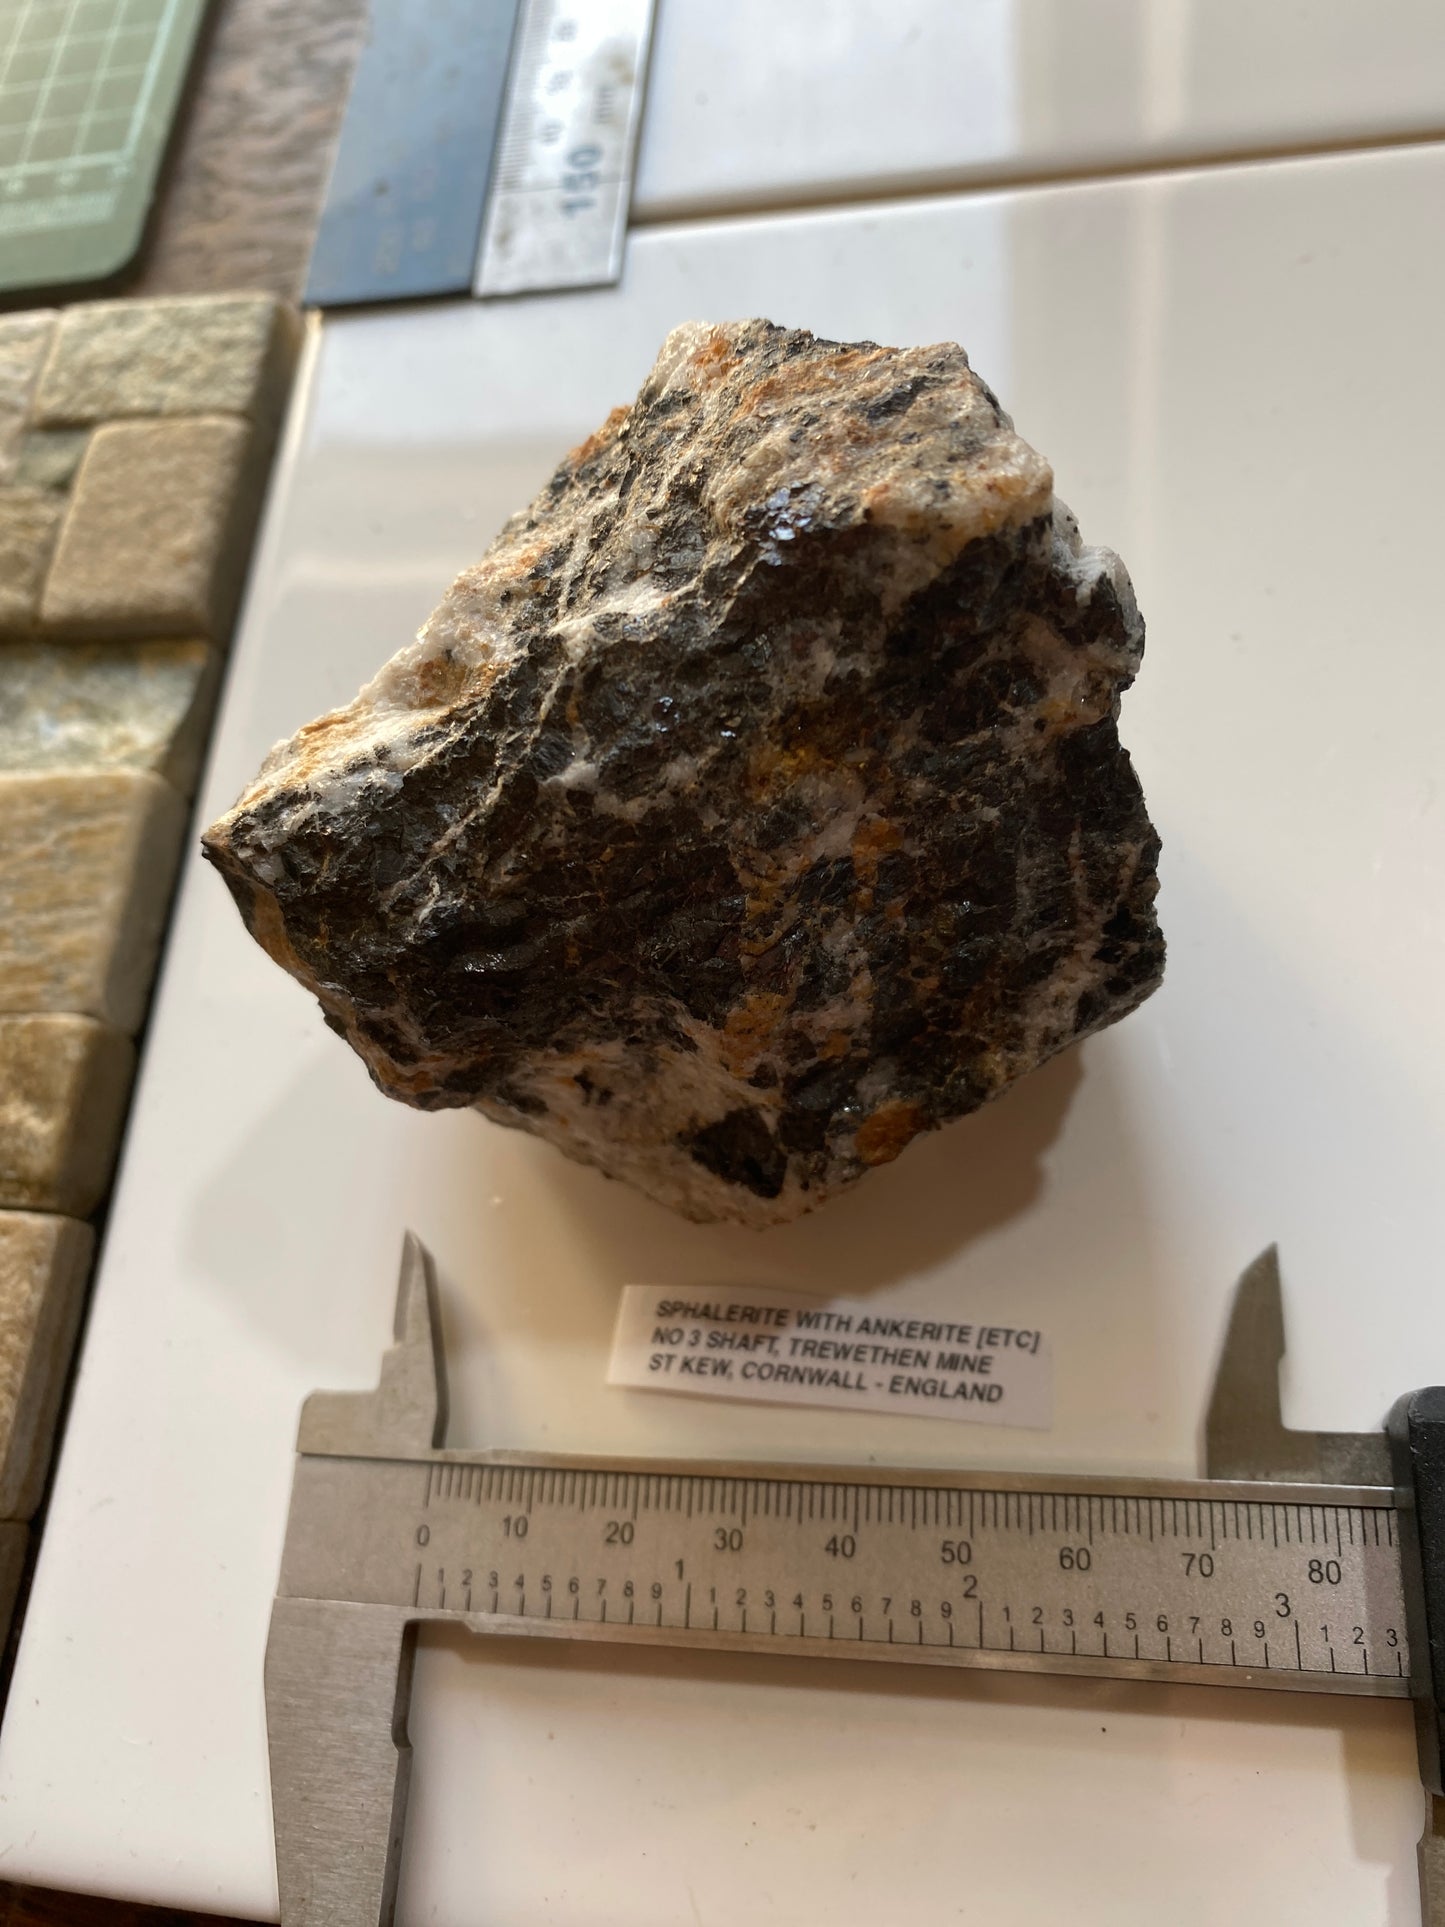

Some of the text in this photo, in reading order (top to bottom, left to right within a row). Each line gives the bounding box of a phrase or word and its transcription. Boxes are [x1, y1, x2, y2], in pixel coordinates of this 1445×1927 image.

[560, 143, 603, 219] 150
[652, 1327, 994, 1374] NO 3 SHAFT, TREWETHEN MINE
[656, 1300, 1041, 1354] SPHALERITE WITH ANKERITE [ETC]
[649, 1353, 676, 1371] ST
[680, 1355, 733, 1380] KEW,
[741, 1361, 867, 1390] CORNWALL
[888, 1375, 1004, 1402] ENGLAND
[416, 1515, 1342, 1585] 0 10 20 30 40 50 60 70 80
[462, 1570, 473, 1586] 2
[489, 1571, 498, 1588] 3
[514, 1574, 525, 1588] 4
[543, 1575, 552, 1591] 5
[569, 1577, 579, 1594] 6
[597, 1579, 606, 1595] 7
[624, 1581, 634, 1597] 8
[652, 1583, 662, 1599] 9
[736, 1588, 747, 1605] 2
[765, 1590, 775, 1607] 3
[793, 1593, 803, 1608] 4
[822, 1594, 832, 1611] 5
[852, 1596, 862, 1613] 6
[882, 1598, 891, 1614] 7
[911, 1600, 921, 1616] 8
[941, 1602, 951, 1618] 9
[963, 1575, 978, 1598] 2
[1032, 1607, 1043, 1623] 2
[1063, 1609, 1074, 1626] 3
[1093, 1611, 1104, 1628] 4
[1125, 1613, 1136, 1630] 5
[1157, 1615, 1168, 1632] 6
[1190, 1617, 1200, 1633] 7
[1221, 1619, 1232, 1636] 8
[1254, 1621, 1265, 1638] 9
[1275, 1593, 1291, 1617] 3
[1353, 1627, 1365, 1644] 2
[1386, 1629, 1398, 1647] 3
